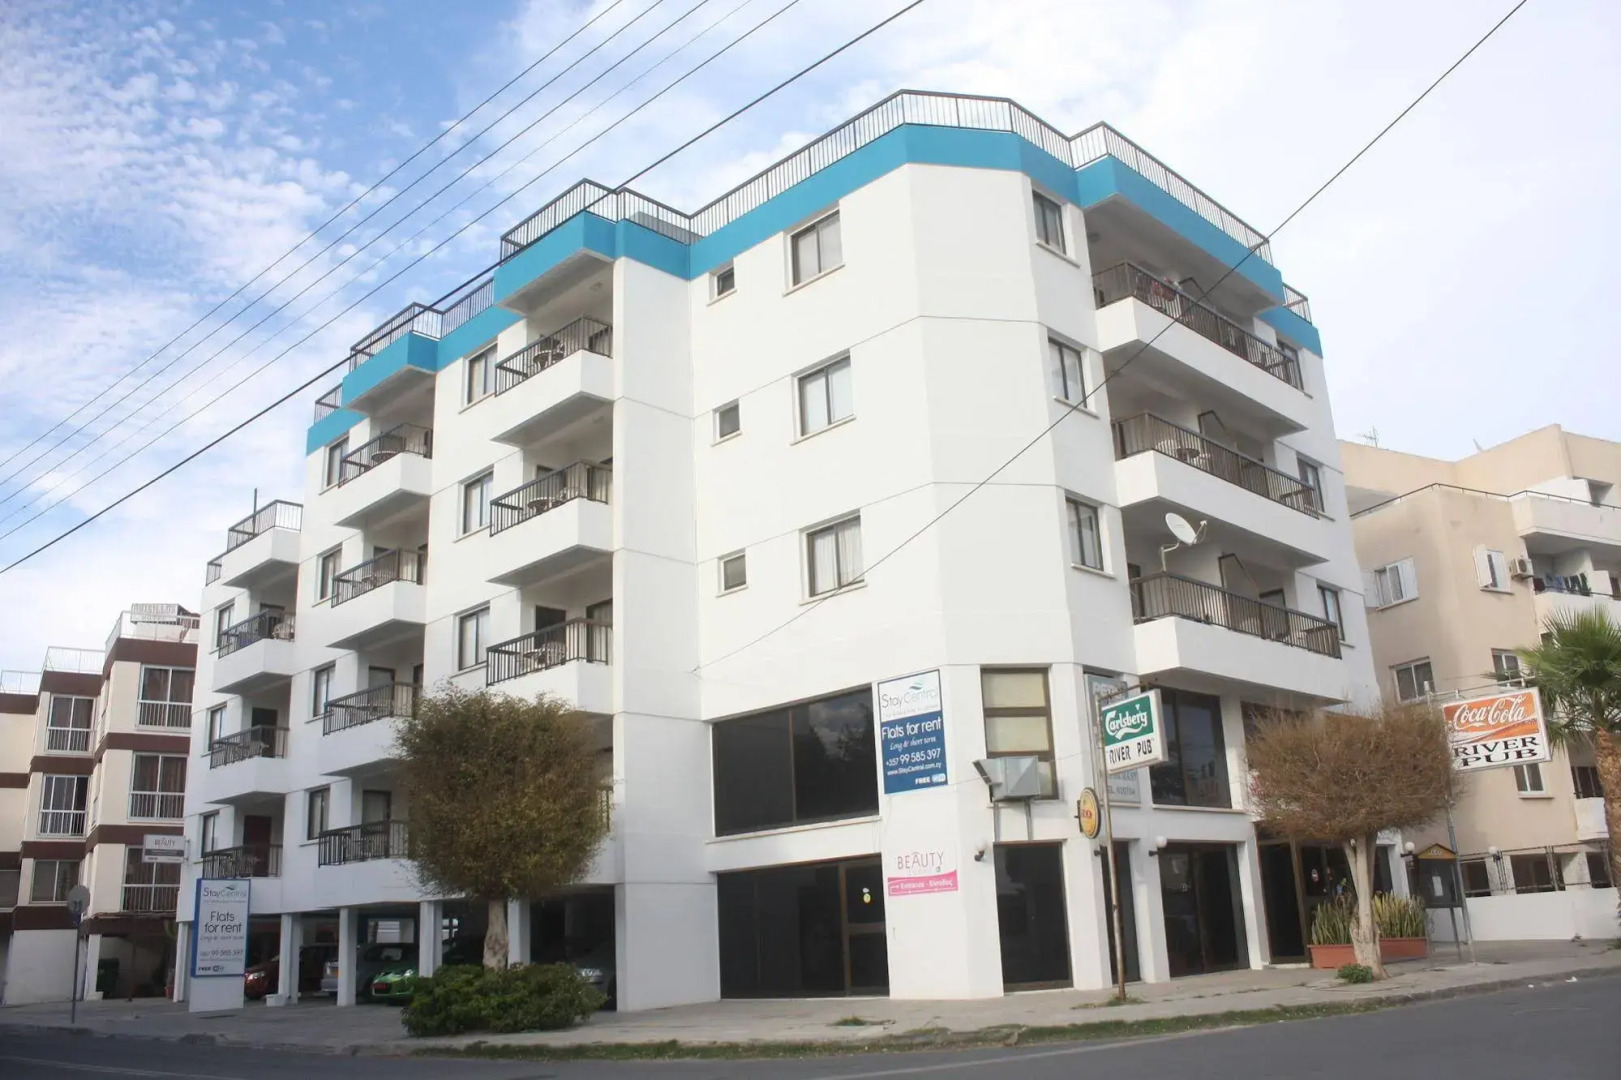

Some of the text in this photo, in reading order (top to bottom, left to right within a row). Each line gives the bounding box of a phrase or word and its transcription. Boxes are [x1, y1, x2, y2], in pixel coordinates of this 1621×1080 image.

[1453, 694, 1528, 730] Coca-Cola
[881, 716, 942, 740] Flats for rent
[1105, 709, 1148, 736] Carlsberg
[890, 742, 903, 752] Long
[1453, 736, 1540, 757] RIVER
[900, 754, 910, 764] 99
[911, 751, 926, 763] 585
[927, 748, 941, 760] 397
[1461, 748, 1538, 767] PUB
[915, 776, 931, 785] FREE
[897, 851, 944, 869] BEAUTY
[210, 911, 235, 921] Flats
[205, 922, 242, 933] for rent
